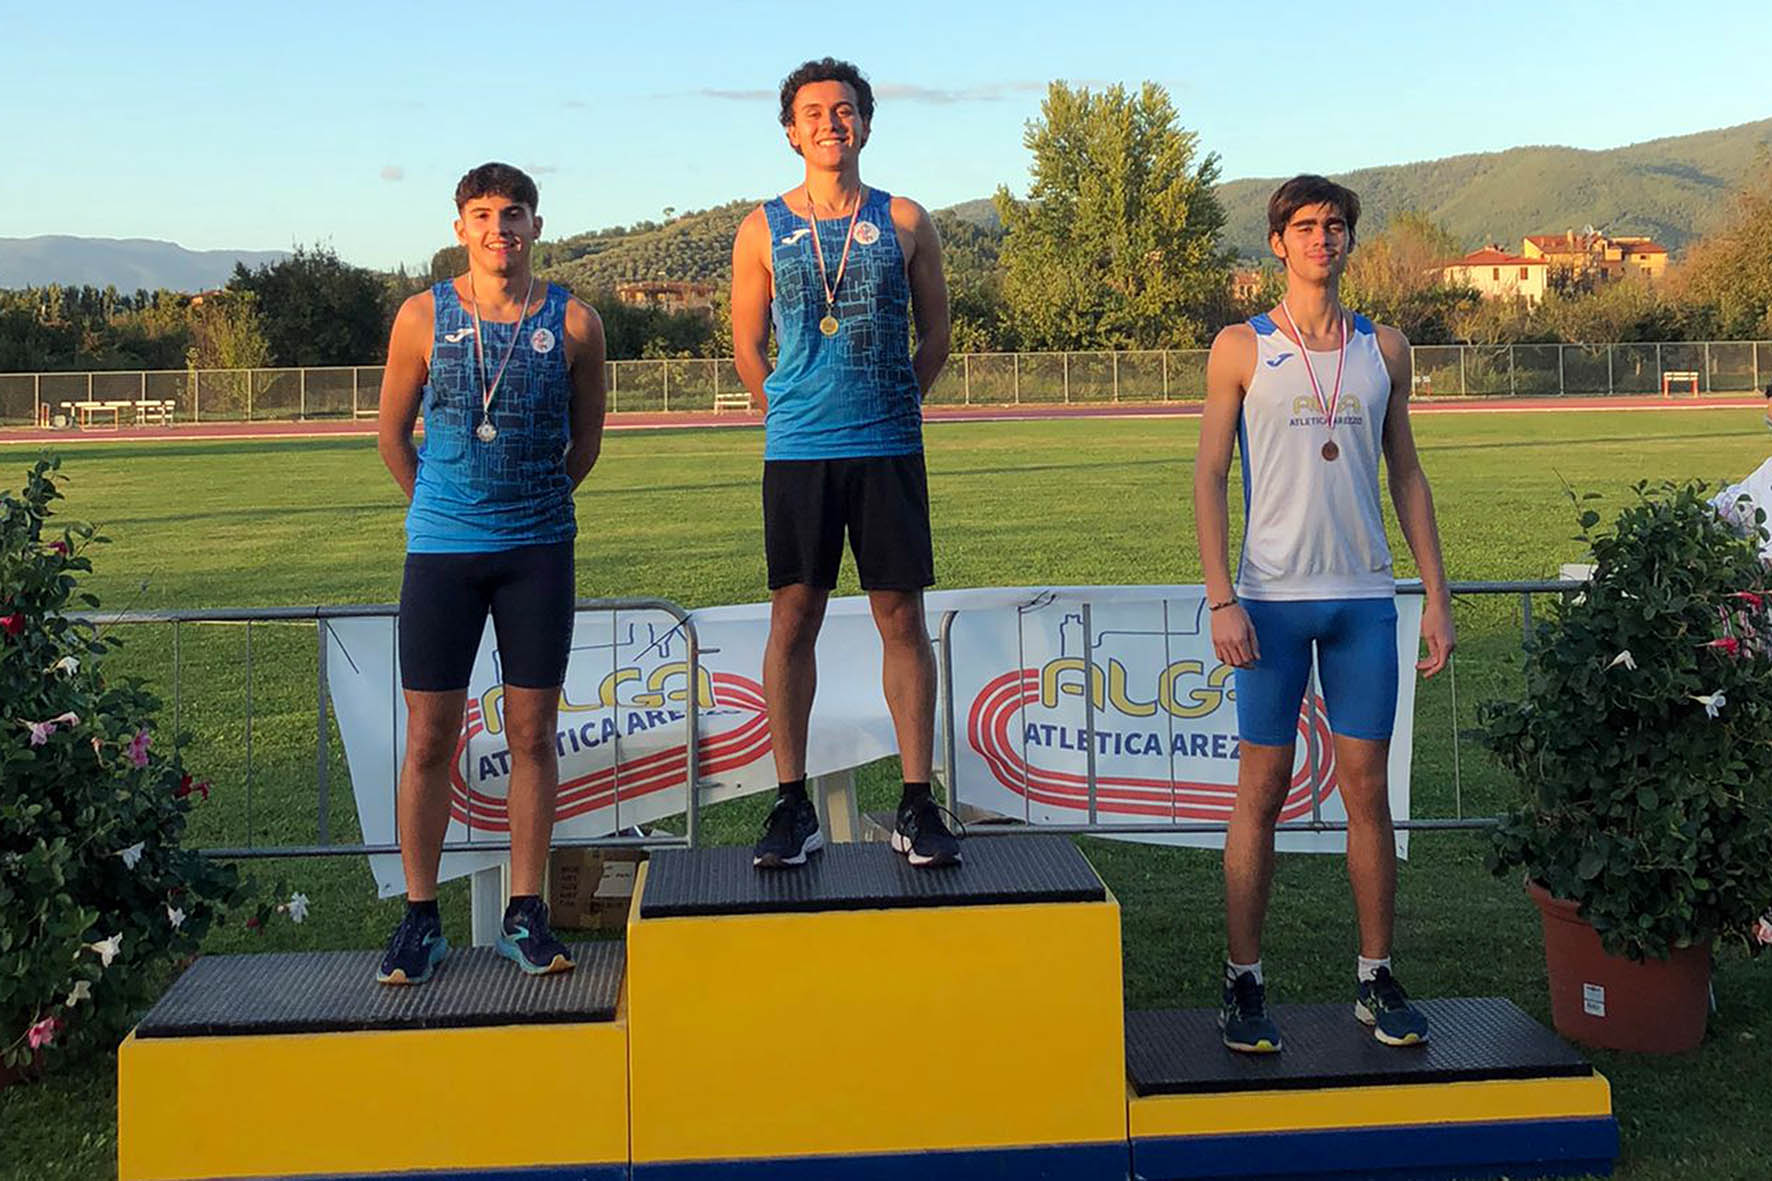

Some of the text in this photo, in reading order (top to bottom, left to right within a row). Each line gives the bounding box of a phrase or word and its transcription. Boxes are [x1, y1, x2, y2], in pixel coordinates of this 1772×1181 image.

[480, 716, 621, 781] ATTICA
[1025, 723, 1240, 759] ATLETICA AREZ
